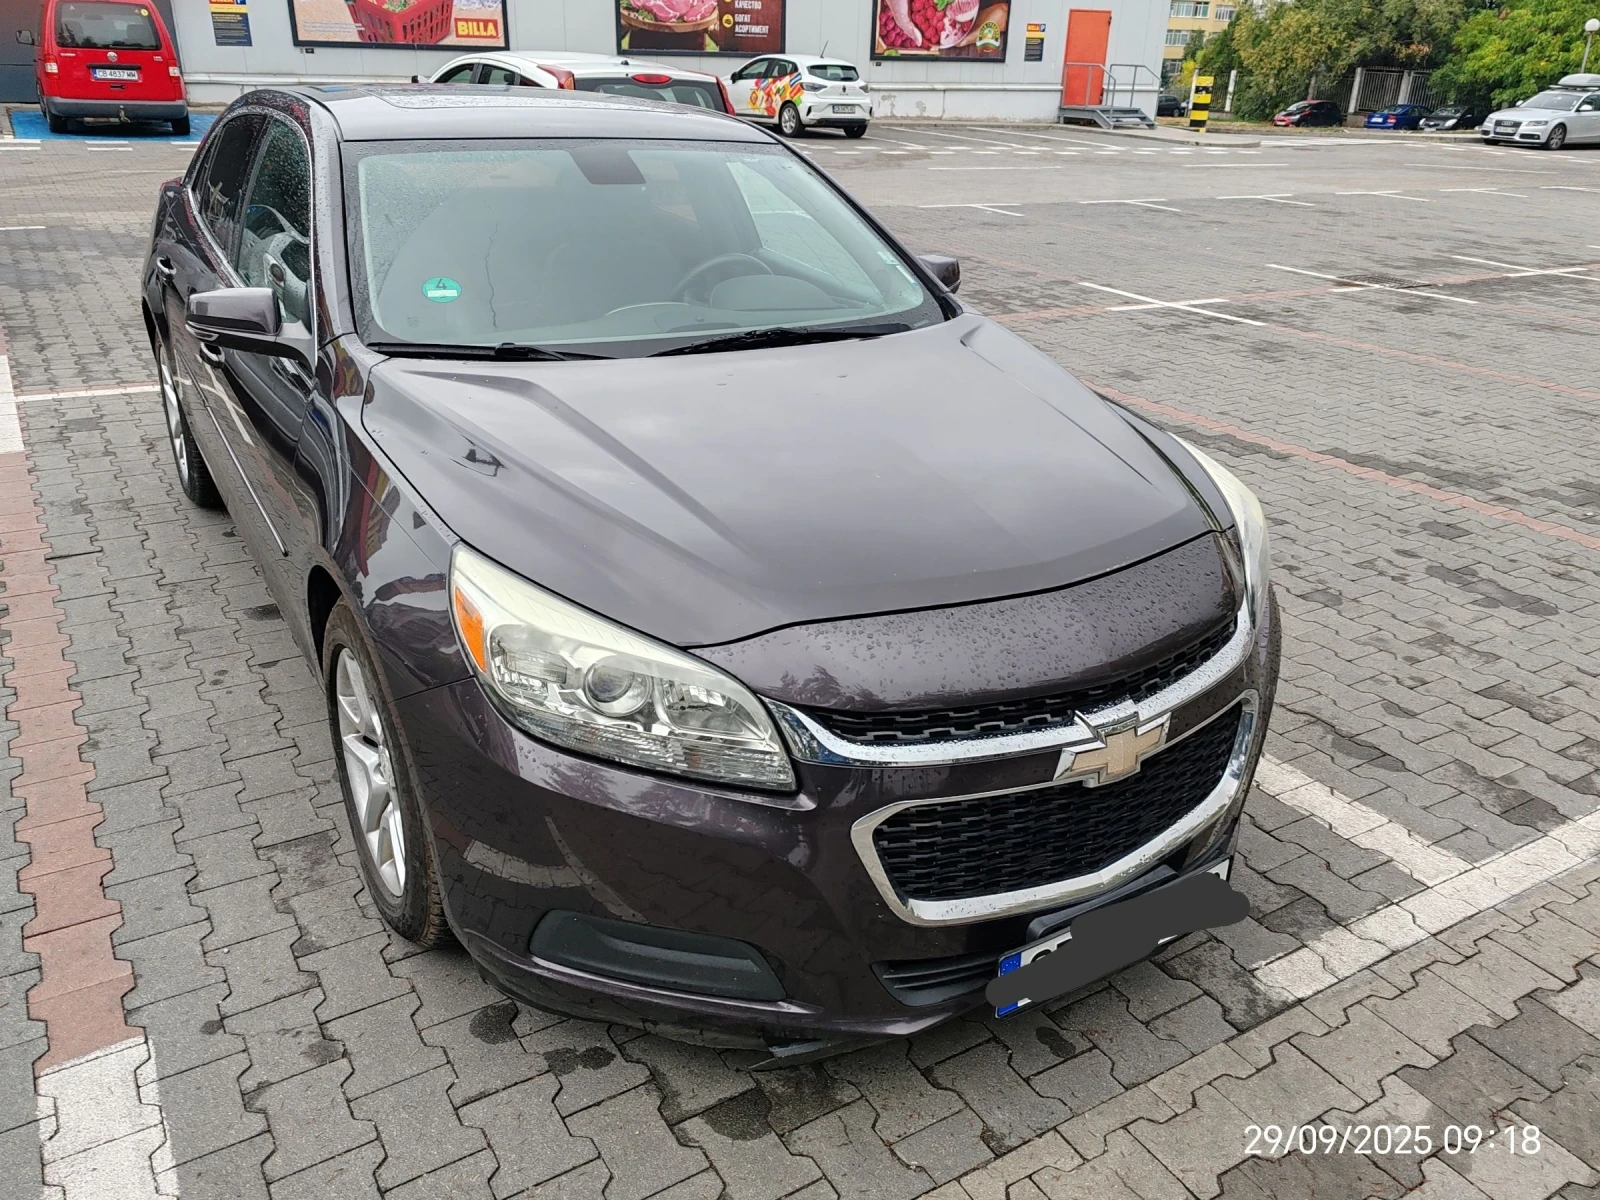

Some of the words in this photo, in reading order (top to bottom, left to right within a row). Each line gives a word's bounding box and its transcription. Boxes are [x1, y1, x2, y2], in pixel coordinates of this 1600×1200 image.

[735, 0, 762, 10] КАЧЕСТВО
[735, 14, 751, 23] БОГАТ
[457, 21, 497, 36] BILLA
[735, 25, 769, 34] АСОРТИМЕНТ
[109, 70, 125, 78] 4837
[436, 278, 447, 290] 4
